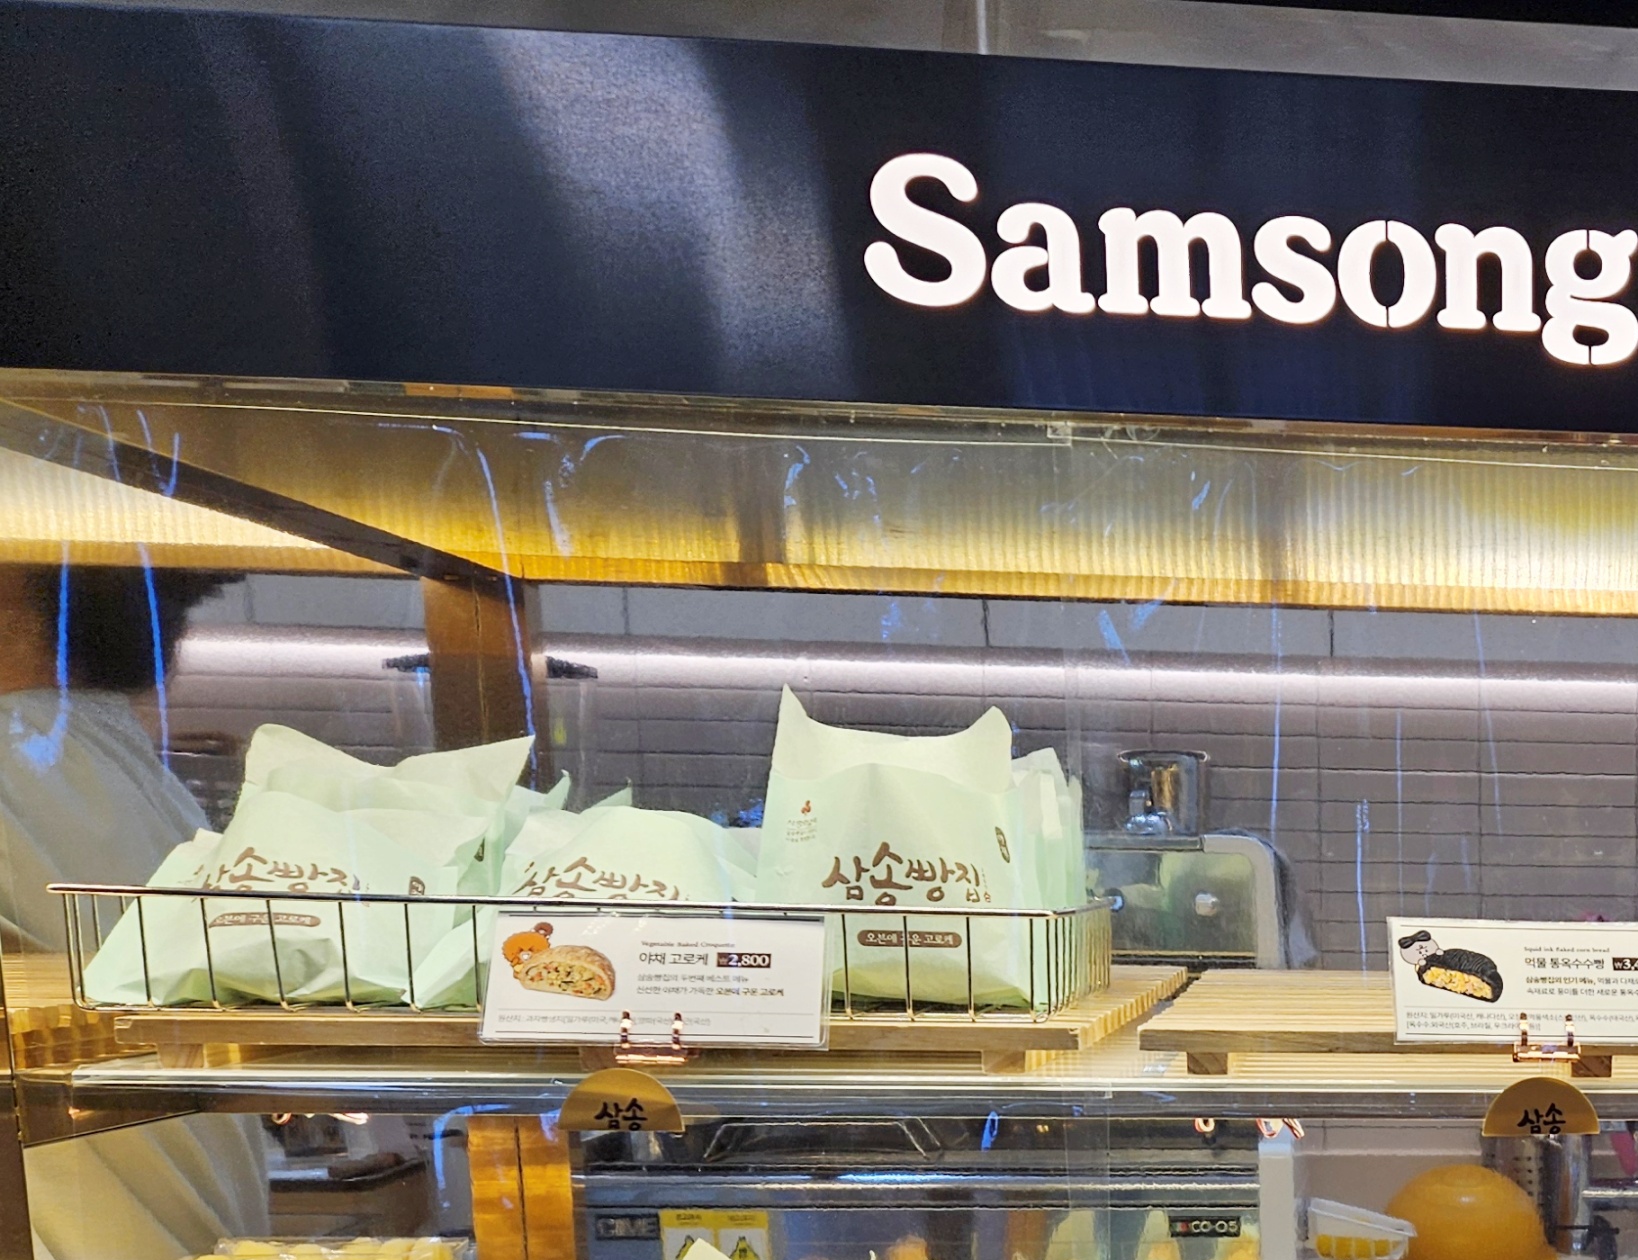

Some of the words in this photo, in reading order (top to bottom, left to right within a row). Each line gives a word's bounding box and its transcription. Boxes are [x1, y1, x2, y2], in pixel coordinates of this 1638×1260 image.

[864, 152, 1638, 366] Samsong
[821, 841, 981, 906] 삼송빵집
[639, 952, 666, 965] 야채
[669, 953, 708, 966] 고로케
[1525, 957, 1546, 969] 먹물
[1550, 957, 1604, 970] 통옥수수빵
[594, 1097, 648, 1131] 삼송
[1517, 1102, 1566, 1135] 삼송
